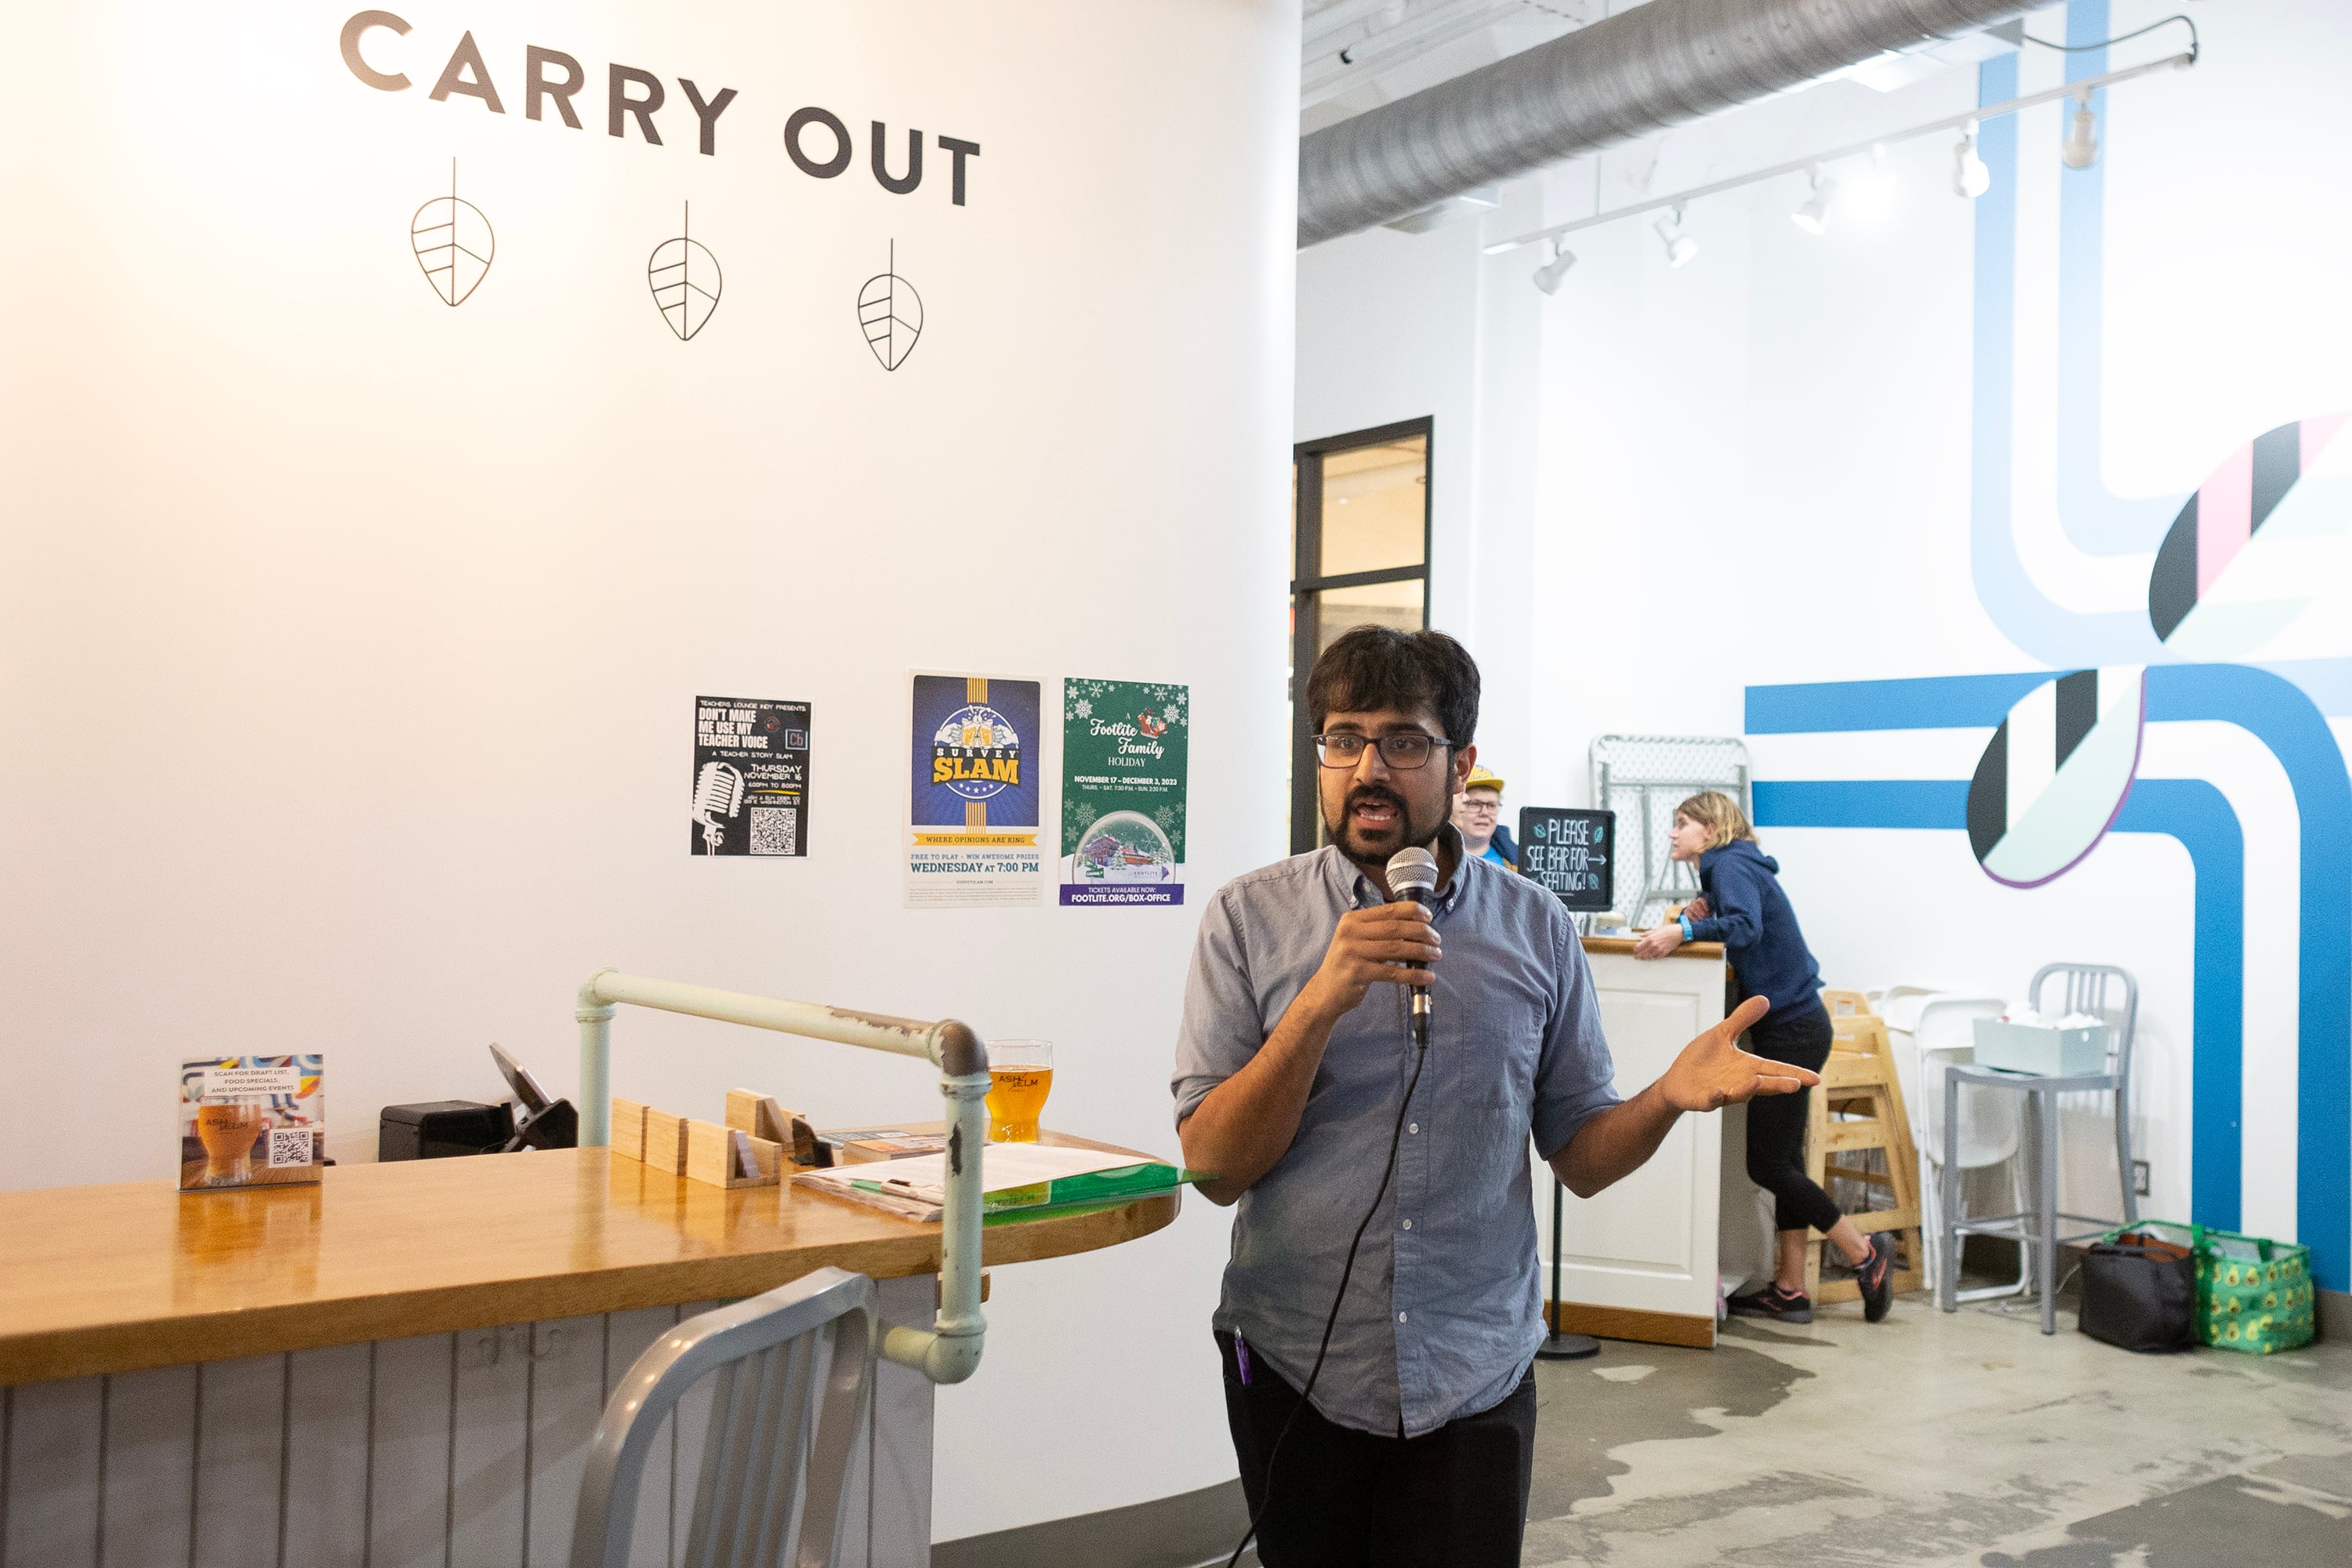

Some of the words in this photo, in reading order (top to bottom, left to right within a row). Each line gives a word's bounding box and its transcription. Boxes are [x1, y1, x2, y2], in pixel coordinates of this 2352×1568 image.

[339, 9, 739, 157] CARRY
[784, 107, 981, 207] OUT
[699, 707, 728, 721] DON'T
[728, 709, 757, 723] MAKE
[698, 720, 714, 733] ME
[716, 721, 735, 735] USE
[737, 723, 753, 735] MY
[1090, 718, 1138, 737] Footlite
[698, 734, 739, 747] TEACHER
[742, 735, 768, 749] VOICE
[1118, 737, 1165, 760] Family
[936, 748, 1018, 758] SURVEY
[750, 764, 802, 773] THURSDAY
[1108, 757, 1146, 767] HOLIDAY
[744, 771, 790, 780] NOVEMBER
[933, 757, 1018, 784] SLAM
[1548, 818, 1589, 845] PLEASE
[1526, 845, 1545, 872] SEE
[1548, 847, 1569, 872] BAR
[1570, 848, 1589, 871] FOR
[910, 862, 983, 873] WEDNESDAY
[997, 862, 1018, 872] 7:00
[1022, 862, 1039, 872] PM
[1541, 871, 1586, 891] SEATING!
[1071, 894, 1171, 902] FOOTLITE.ORG/BOX-OFFICE
